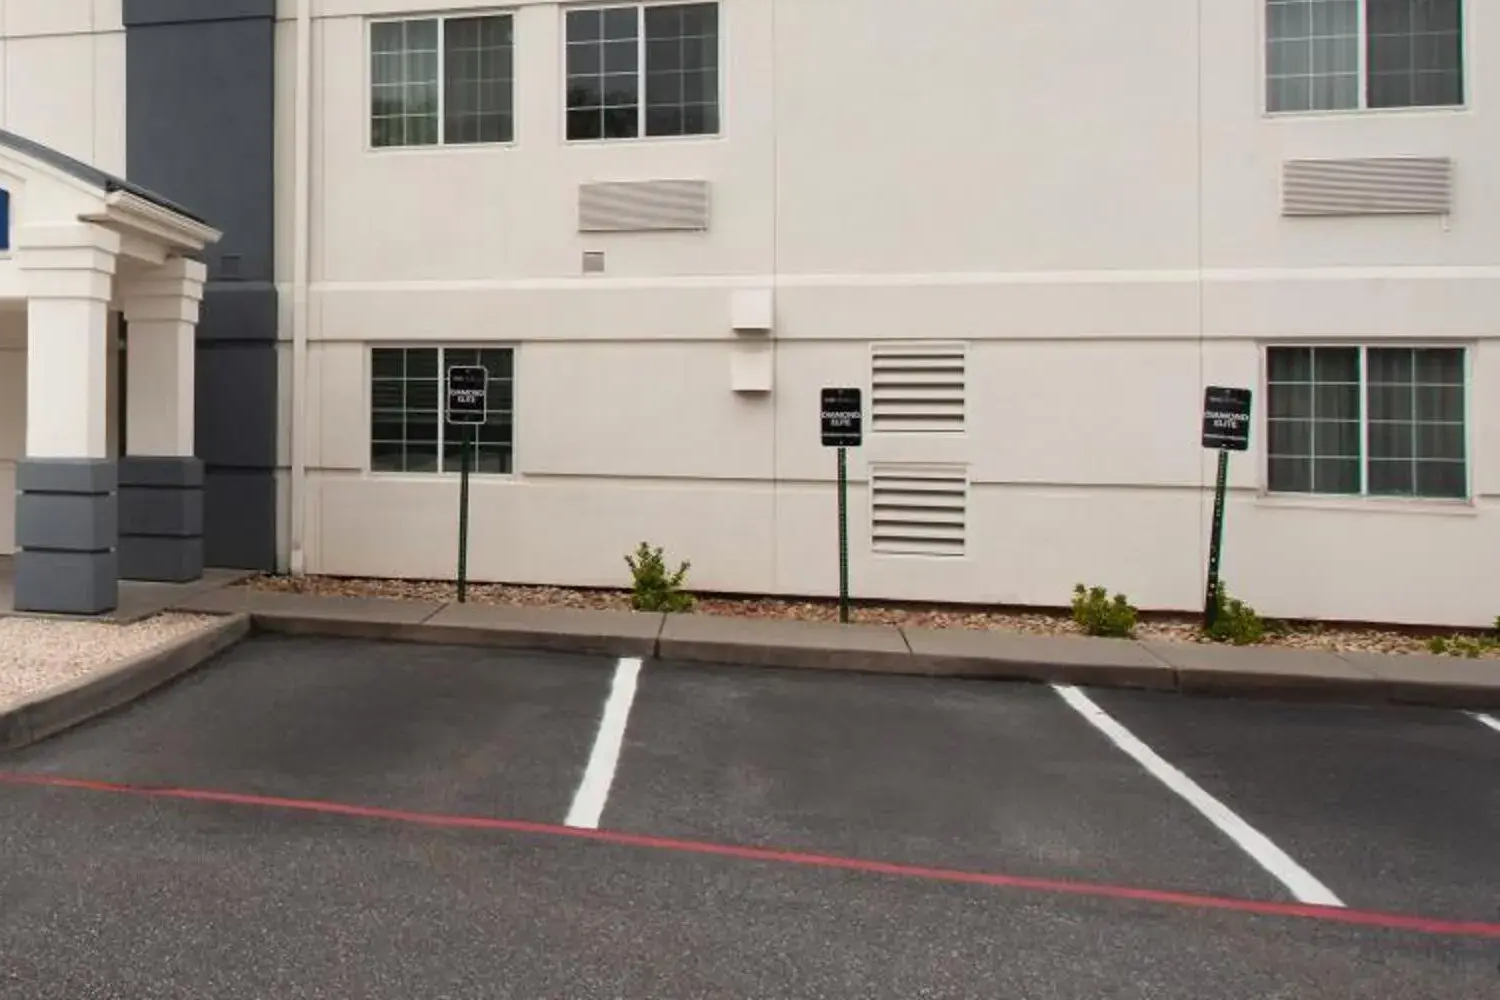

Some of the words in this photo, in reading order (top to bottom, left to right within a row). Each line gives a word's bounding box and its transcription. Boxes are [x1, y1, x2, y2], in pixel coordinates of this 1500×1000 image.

[821, 411, 862, 419] DIAMOND
[1204, 410, 1250, 421] DIAMOND
[1212, 419, 1237, 429] ELITE
